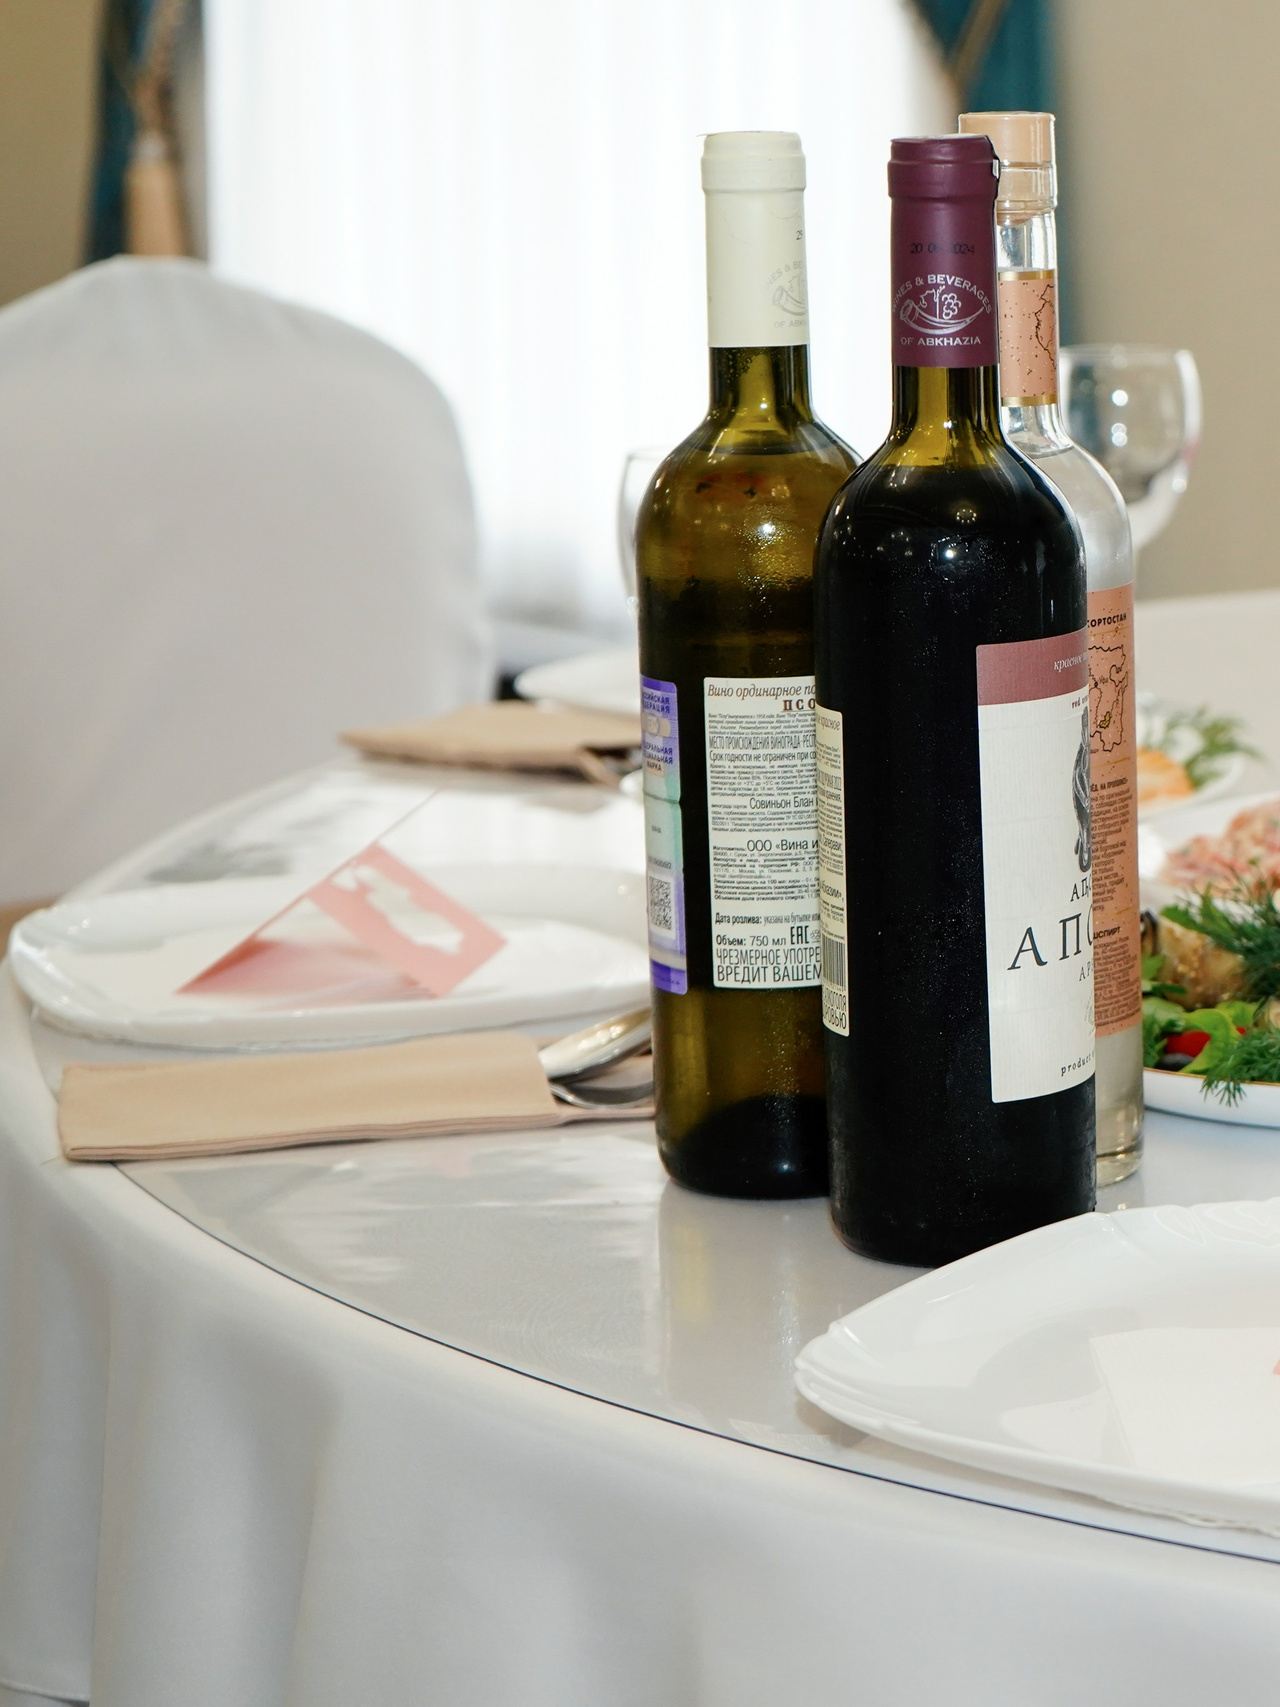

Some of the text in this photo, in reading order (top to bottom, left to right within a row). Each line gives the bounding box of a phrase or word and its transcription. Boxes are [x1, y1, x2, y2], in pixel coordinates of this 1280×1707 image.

[892, 274, 992, 315] WINES & BEVERAGES
[901, 336, 981, 346] OF ABKHAZIA
[1053, 655, 1083, 673] красное
[707, 684, 733, 697] Вино
[735, 684, 802, 700] ординарное
[1072, 696, 1081, 709] red
[709, 735, 770, 750] МЕСТО ПРОИСХОЖДЕНИЯ
[709, 750, 809, 763] Срок годности не ограничен при
[749, 796, 813, 810] Совиньон Блан
[747, 839, 772, 852] ООО
[776, 839, 808, 851] «Вина
[715, 912, 731, 924] Дата
[732, 915, 762, 925] розлива:
[716, 934, 786, 946] Объем: 750 мл
[716, 947, 781, 966] ЧРЕЗМЕРНОЕ
[717, 965, 768, 984] ВРЕДИТ
[1061, 1053, 1091, 1077] product
